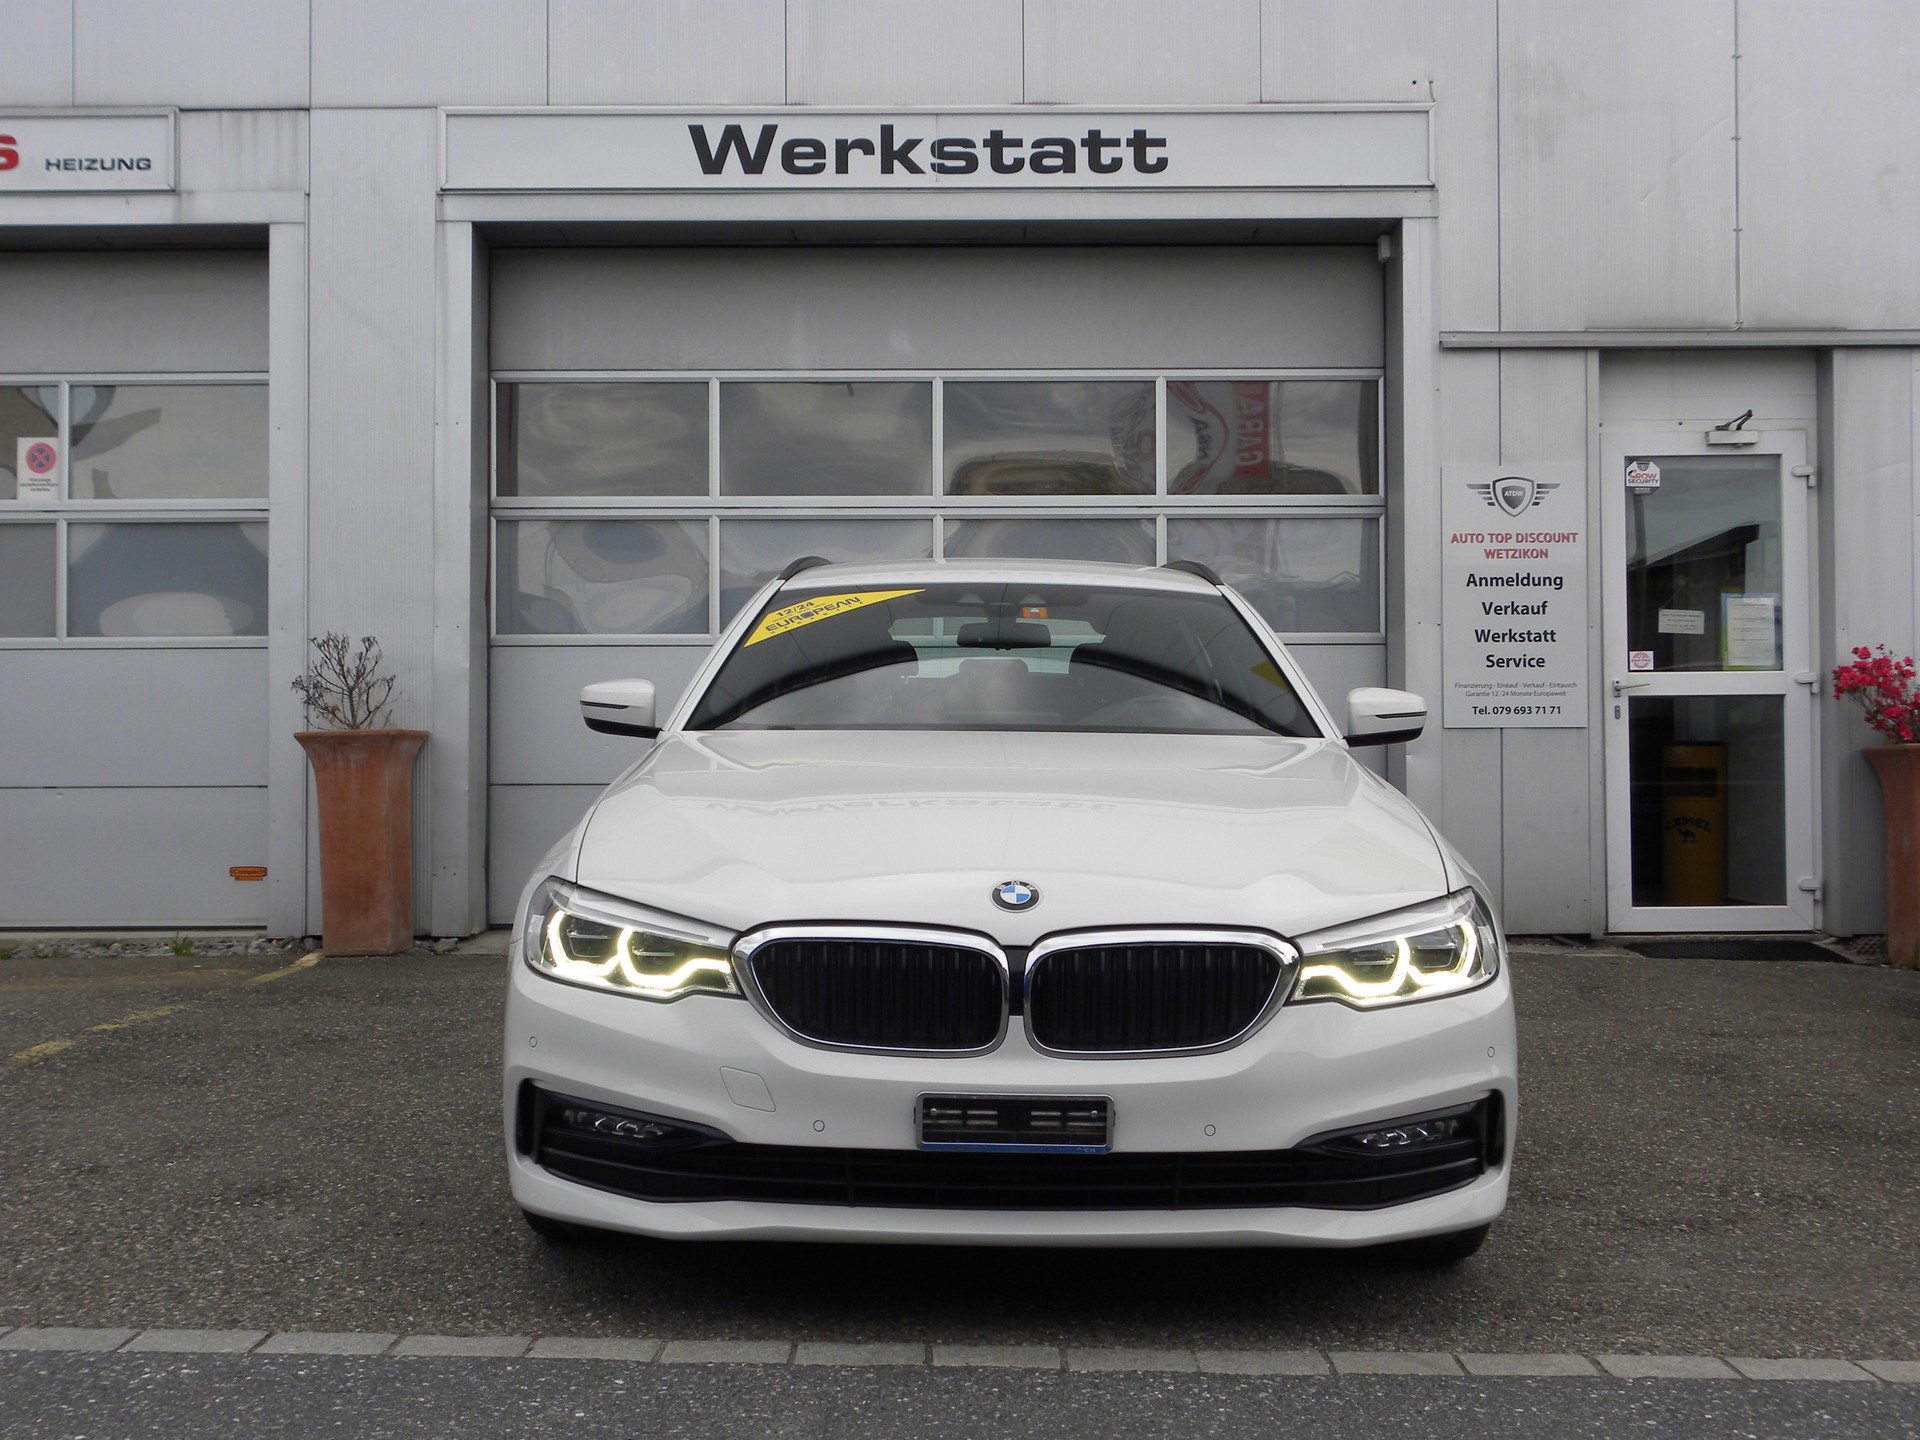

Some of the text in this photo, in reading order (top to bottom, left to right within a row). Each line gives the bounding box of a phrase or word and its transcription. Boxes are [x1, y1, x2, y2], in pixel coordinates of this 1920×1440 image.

[688, 123, 1169, 175] Werkstatt
[45, 157, 151, 171] HEIZUNG
[1450, 532, 1578, 543] AUTO TOP DISCOUNT
[1484, 548, 1549, 559] WETZIKON
[1466, 572, 1563, 590] Anmeldung
[765, 596, 861, 632] EUROPEAN
[1481, 601, 1548, 615] Verkauf
[1474, 628, 1557, 643] Werkstatt
[1486, 654, 1546, 668] Service
[1472, 706, 1561, 715] Tel. 079 693 71 71
[1665, 816, 1712, 832] CAMEL
